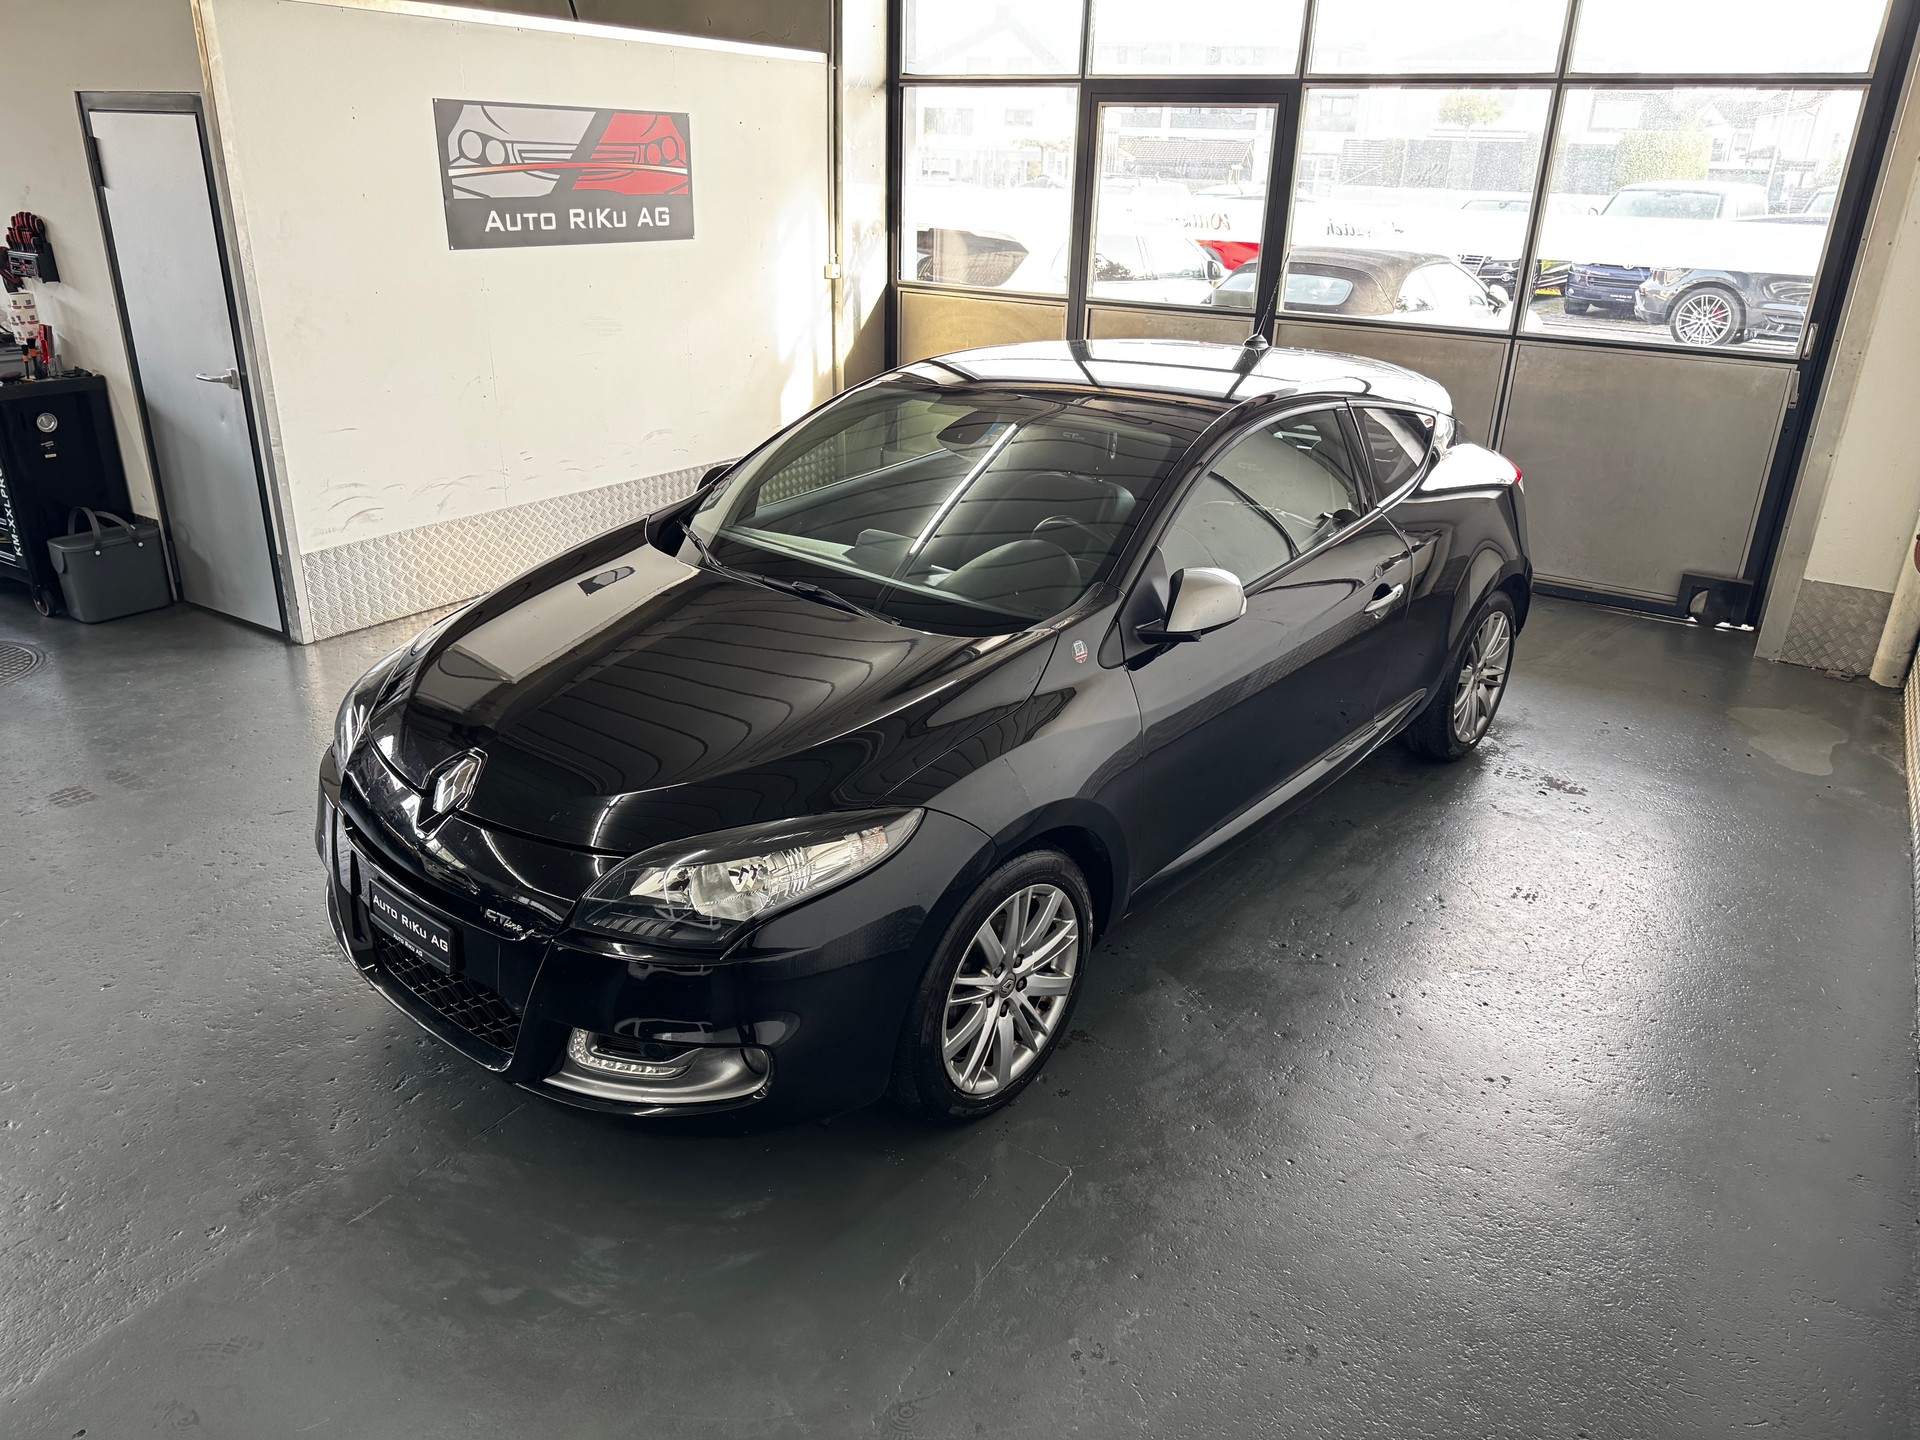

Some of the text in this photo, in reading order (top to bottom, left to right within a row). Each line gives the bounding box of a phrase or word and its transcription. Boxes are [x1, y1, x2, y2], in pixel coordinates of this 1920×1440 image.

[485, 210, 557, 232] AUTO
[637, 206, 670, 227] AG
[373, 894, 398, 920] AUTO
[431, 934, 448, 953] AG
